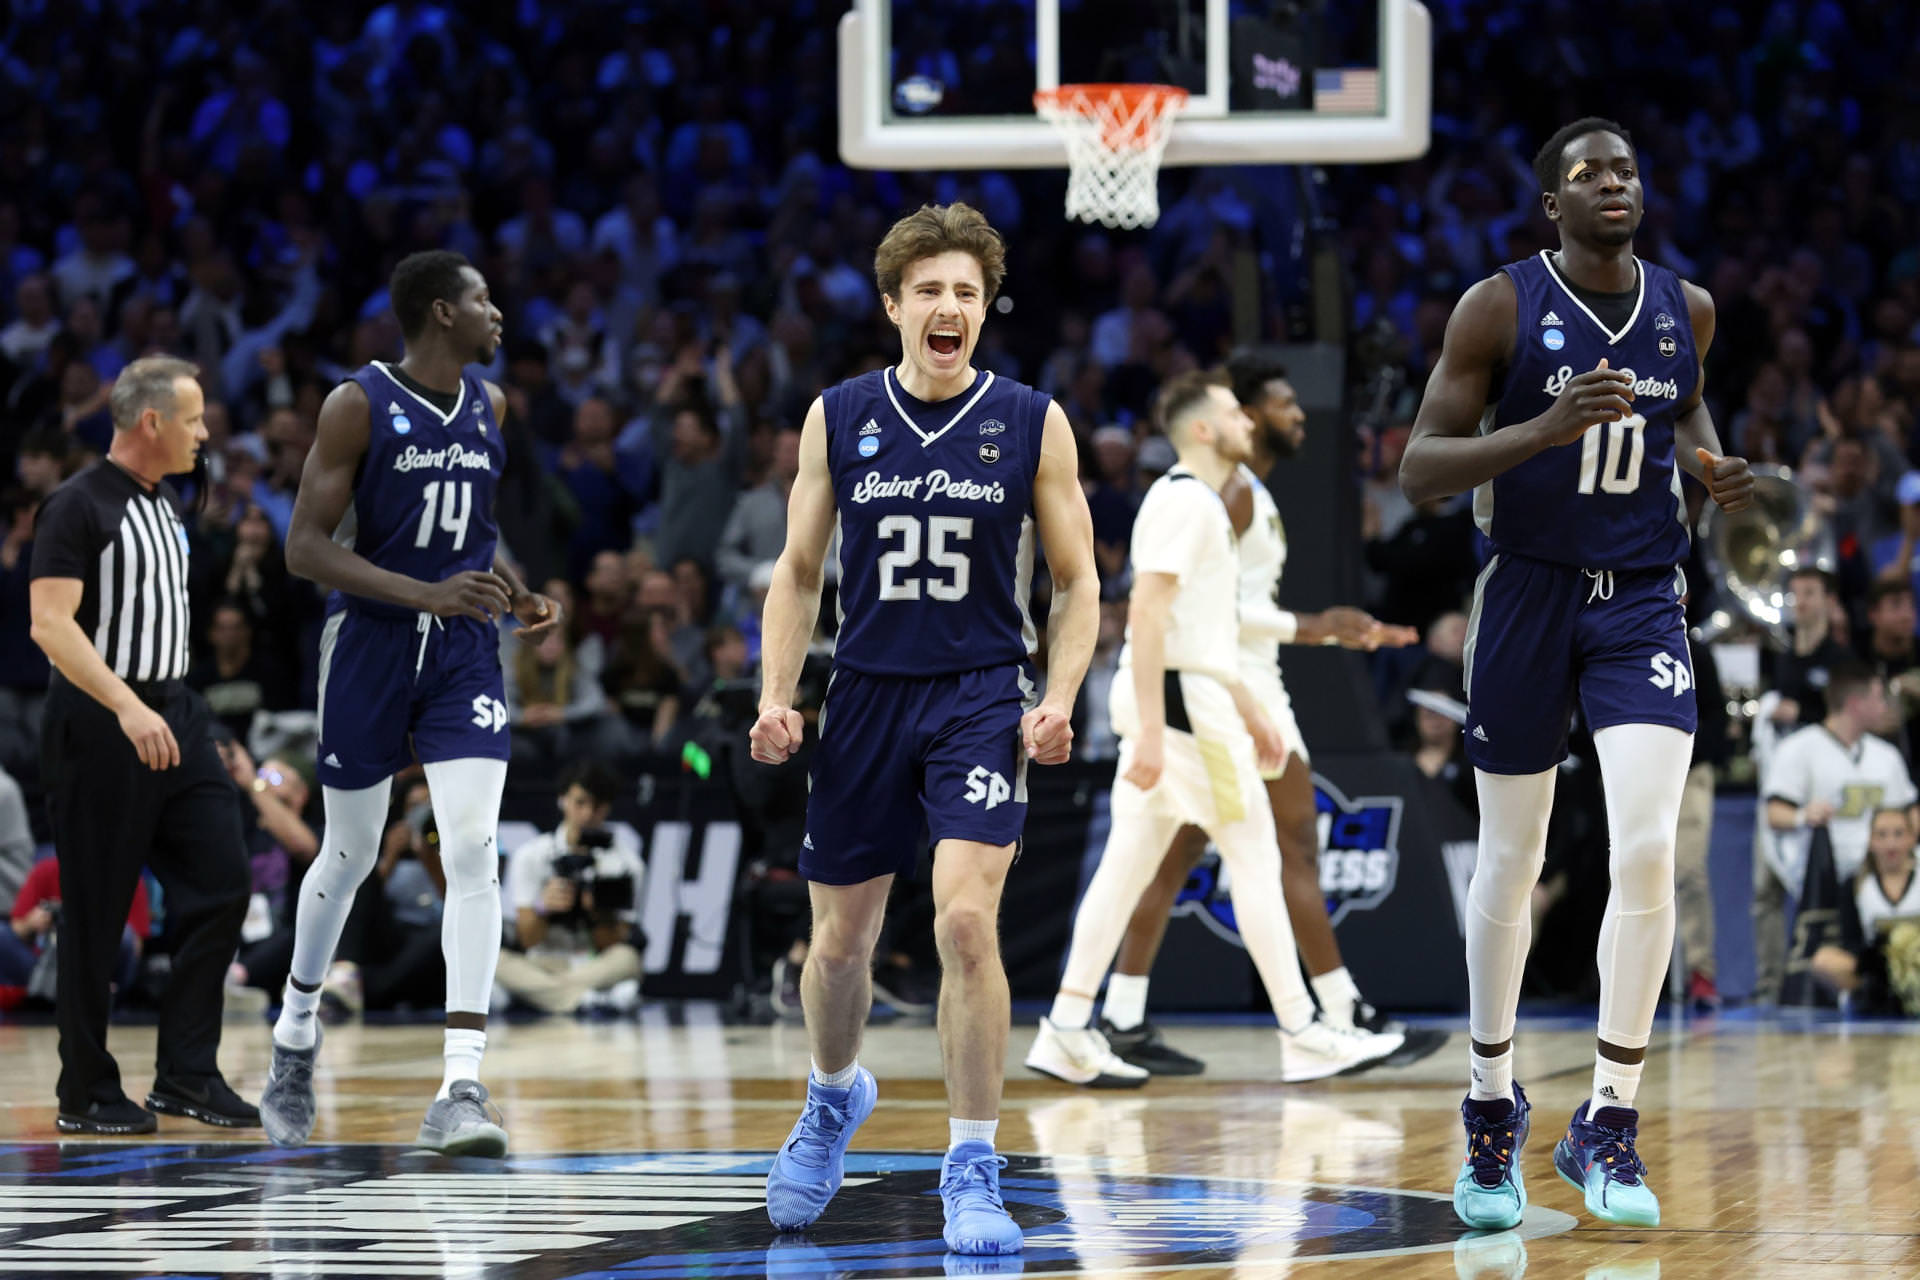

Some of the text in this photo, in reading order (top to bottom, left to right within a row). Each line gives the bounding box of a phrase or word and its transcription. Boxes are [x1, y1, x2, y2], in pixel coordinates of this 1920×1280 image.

[393, 445, 446, 472] Saint
[981, 447, 998, 458] BLM
[1578, 413, 1647, 494] 10
[851, 468, 1005, 504] Saint Peter's
[415, 481, 472, 551] 14
[877, 514, 974, 602] 25
